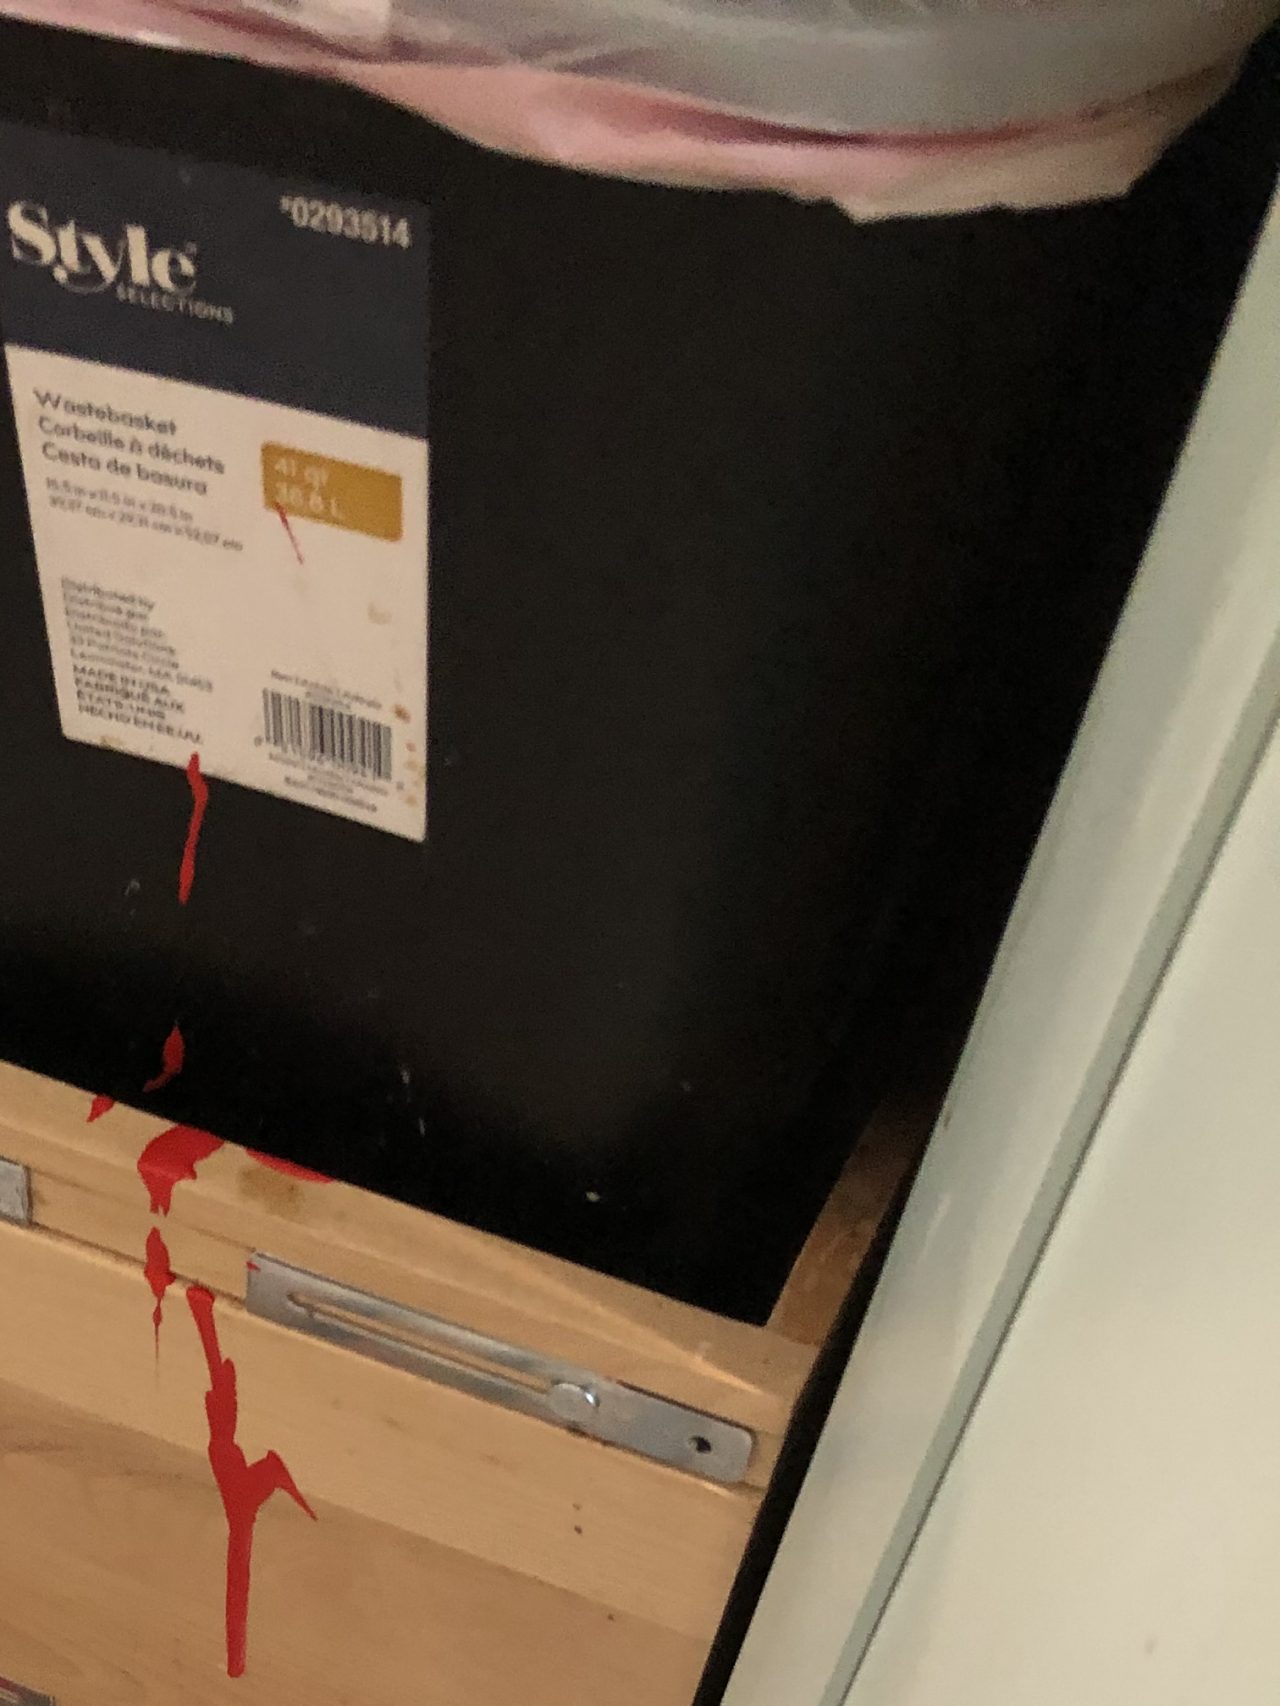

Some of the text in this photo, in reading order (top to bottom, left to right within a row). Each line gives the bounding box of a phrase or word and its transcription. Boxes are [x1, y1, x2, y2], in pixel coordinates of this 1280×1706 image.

[7, 199, 197, 293] Style
[117, 285, 235, 326] SELECTIONS
[33, 387, 177, 436] Wastebasket
[42, 441, 208, 496] Cesta de basura
